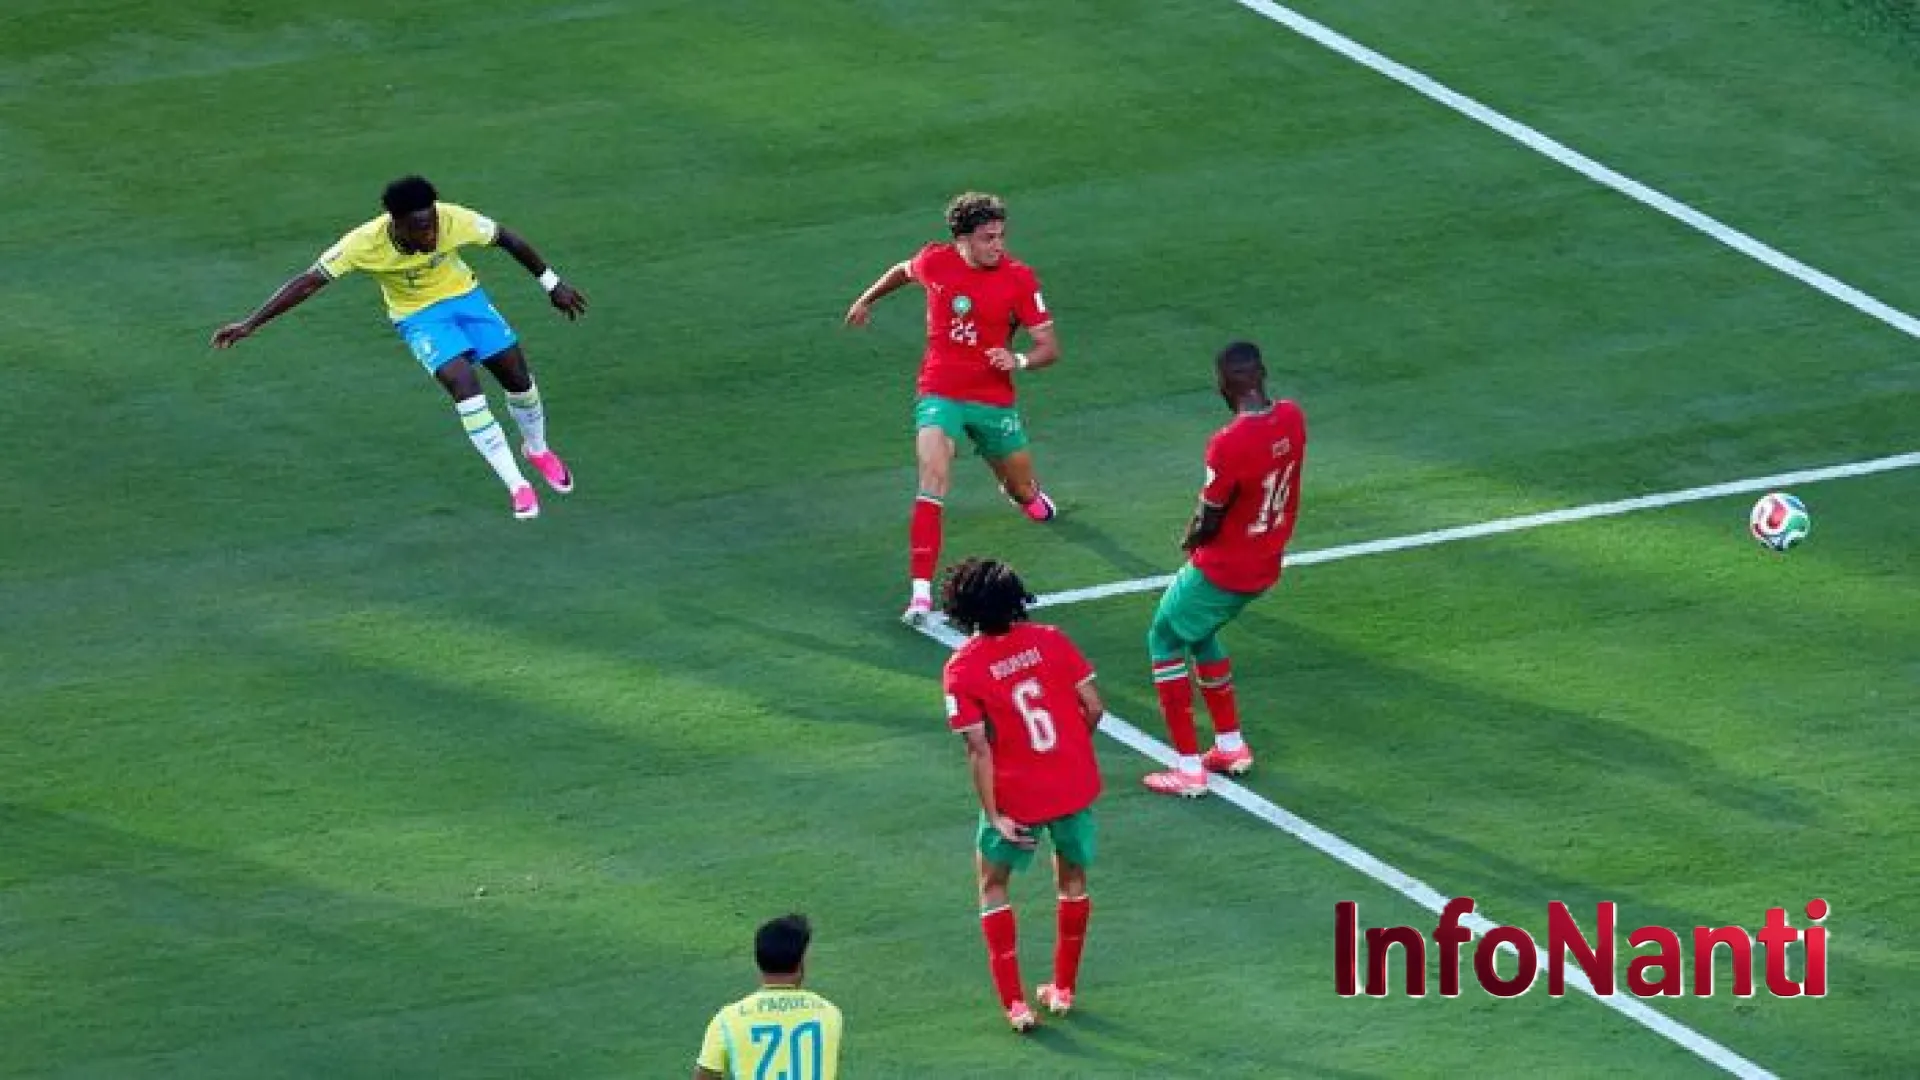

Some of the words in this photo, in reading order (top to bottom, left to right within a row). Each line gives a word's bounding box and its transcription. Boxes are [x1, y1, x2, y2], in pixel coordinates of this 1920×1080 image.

[949, 317, 977, 346] 24
[1247, 460, 1295, 535] 14
[1012, 677, 1056, 753] 6
[750, 1020, 824, 1080] 20
